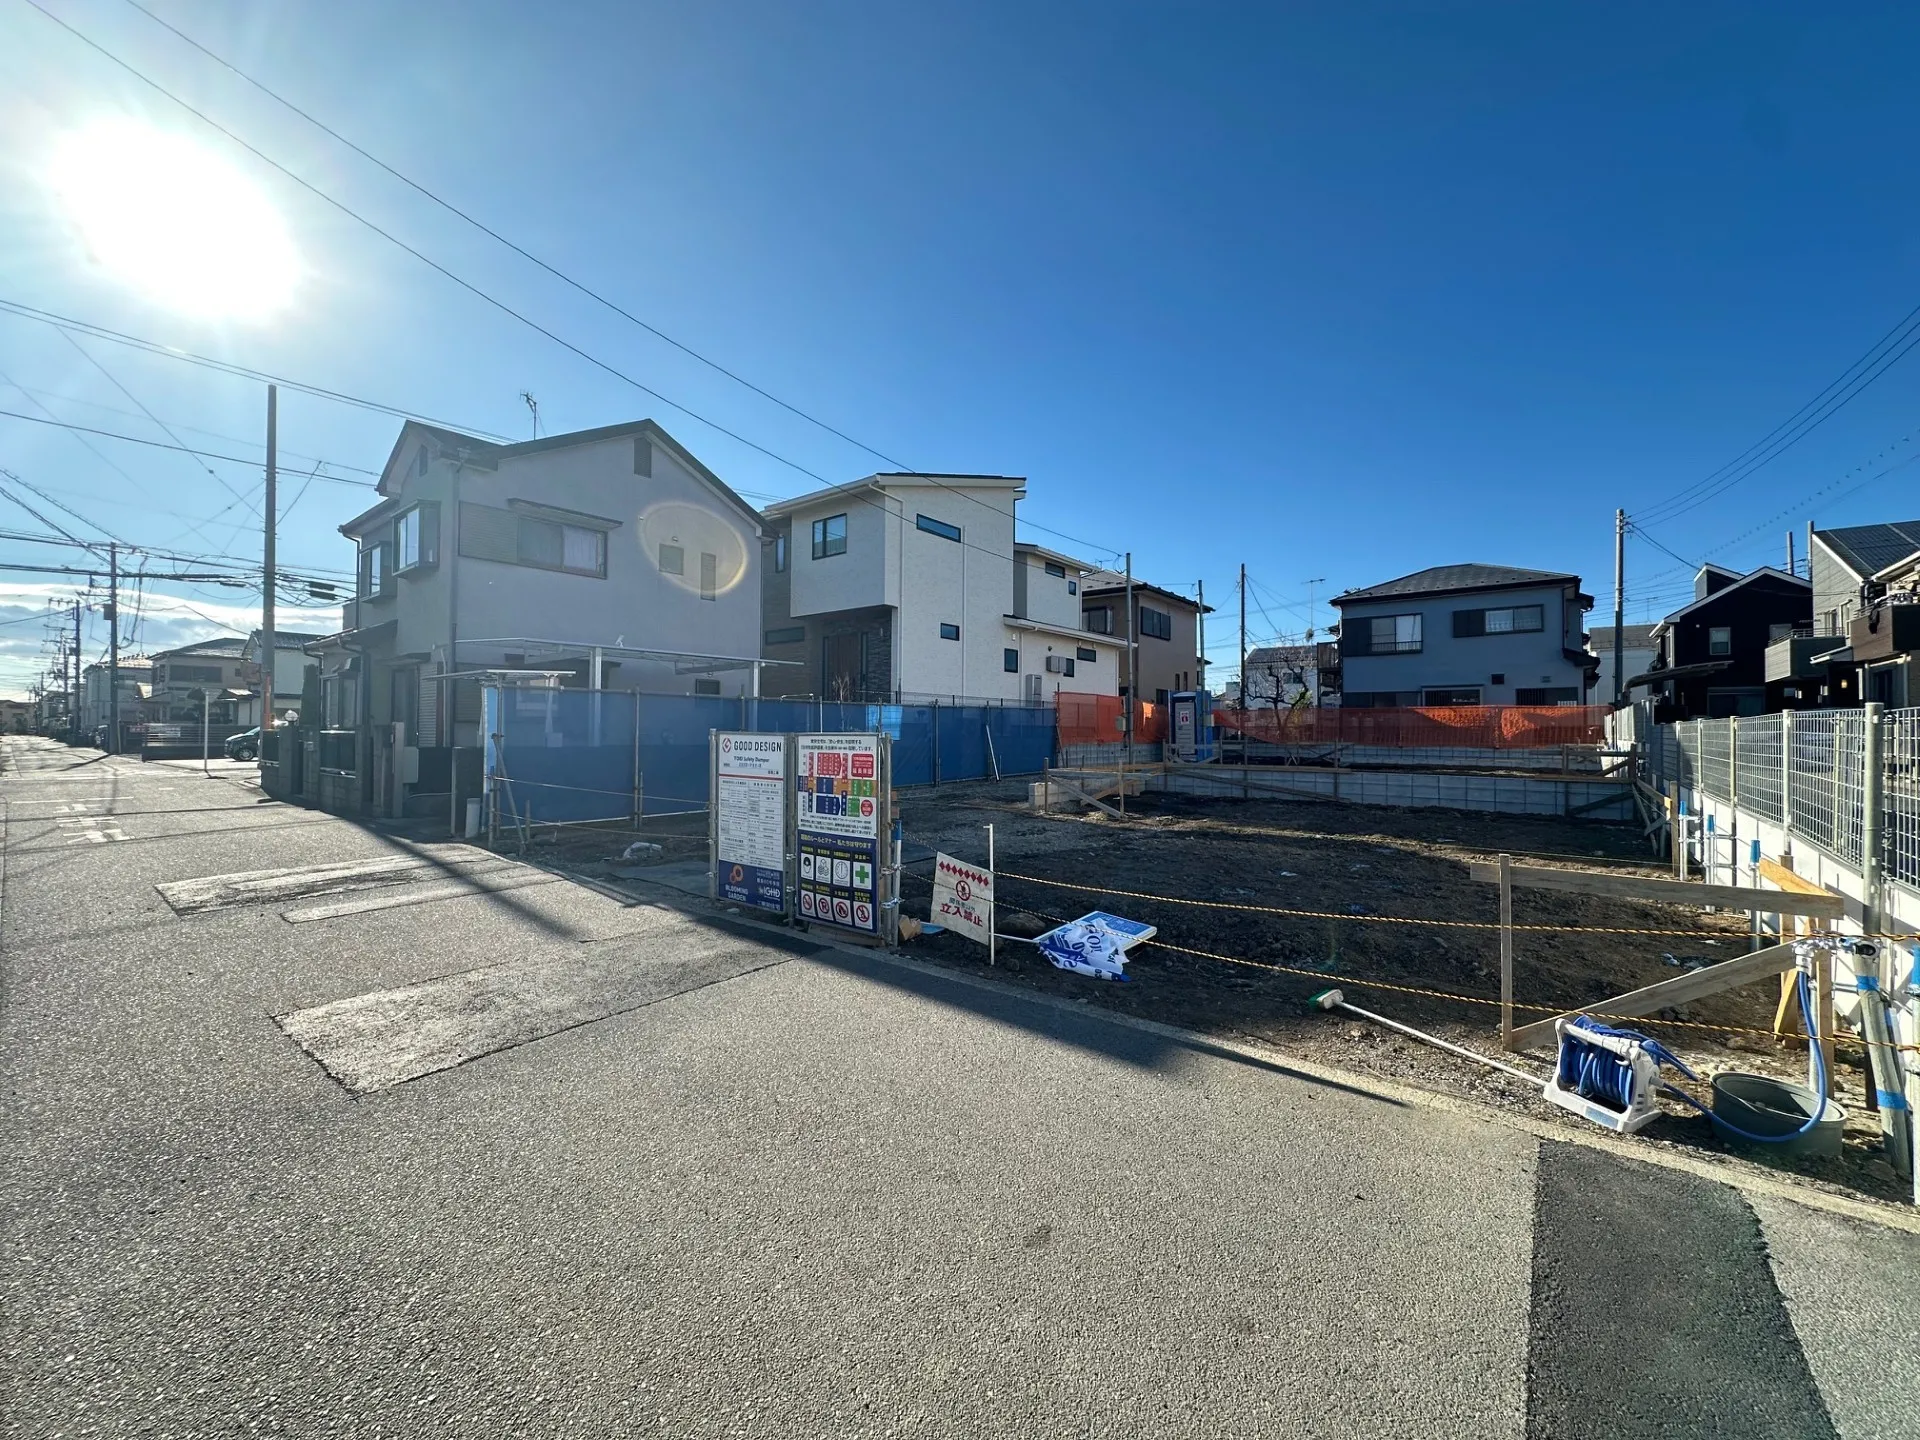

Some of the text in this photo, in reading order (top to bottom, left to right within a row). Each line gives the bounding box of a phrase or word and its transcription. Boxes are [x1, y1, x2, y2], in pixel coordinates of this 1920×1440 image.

[733, 740, 782, 752] GOOD DESIGN
[725, 884, 748, 895] BLOOMING
[728, 892, 747, 902] GARDEN
[948, 896, 976, 912] 関係者以外
[939, 902, 983, 928] 立入禁止
